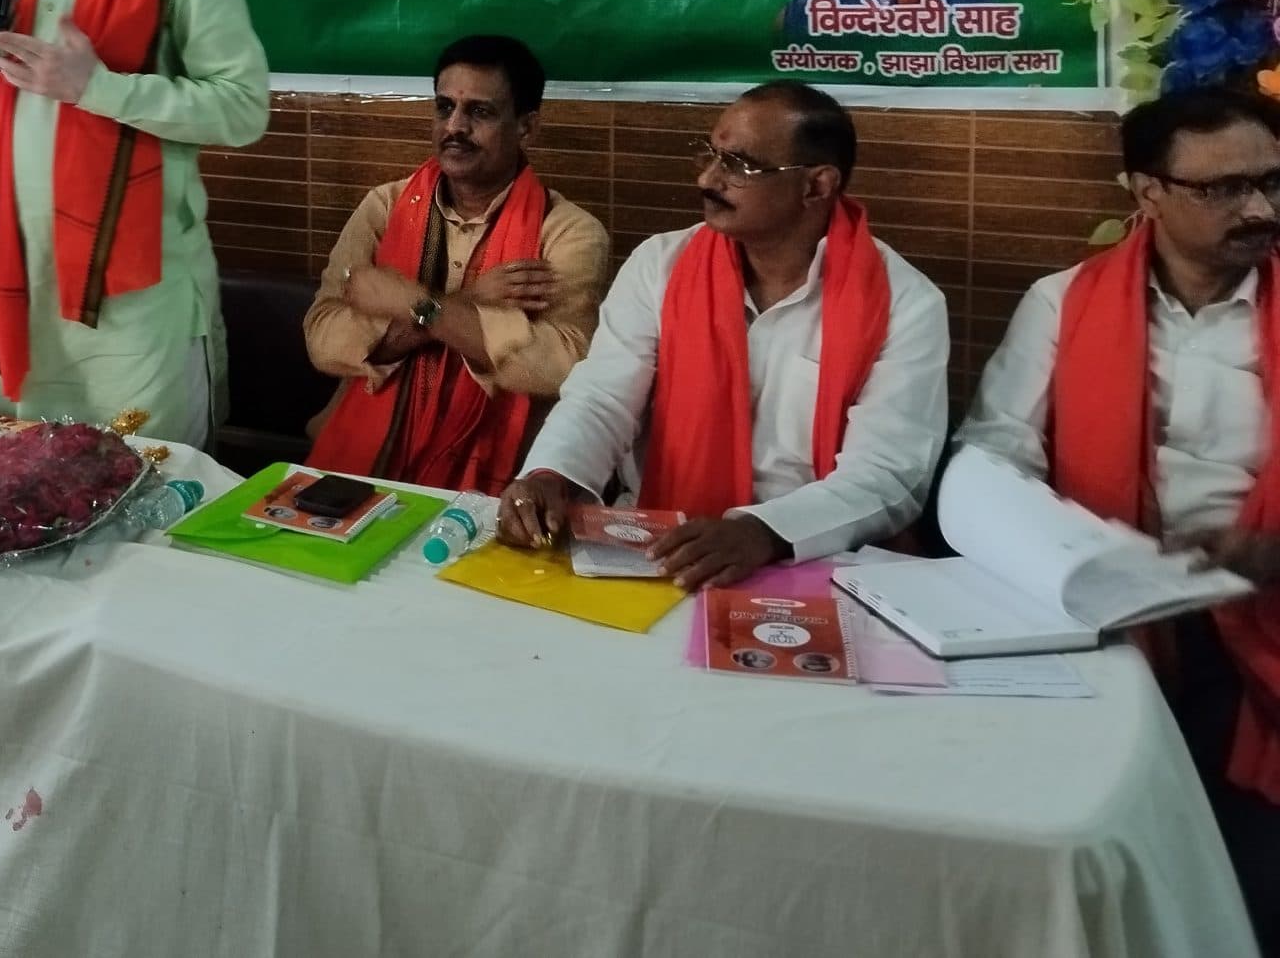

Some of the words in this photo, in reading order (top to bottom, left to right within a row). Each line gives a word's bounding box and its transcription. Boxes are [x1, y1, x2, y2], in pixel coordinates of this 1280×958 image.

[956, 6, 1018, 36] साह
[774, 47, 859, 69] संयोजक
[881, 54, 936, 74] झाझा
[943, 48, 1008, 71] विधान
[1012, 52, 1059, 72] सभा
